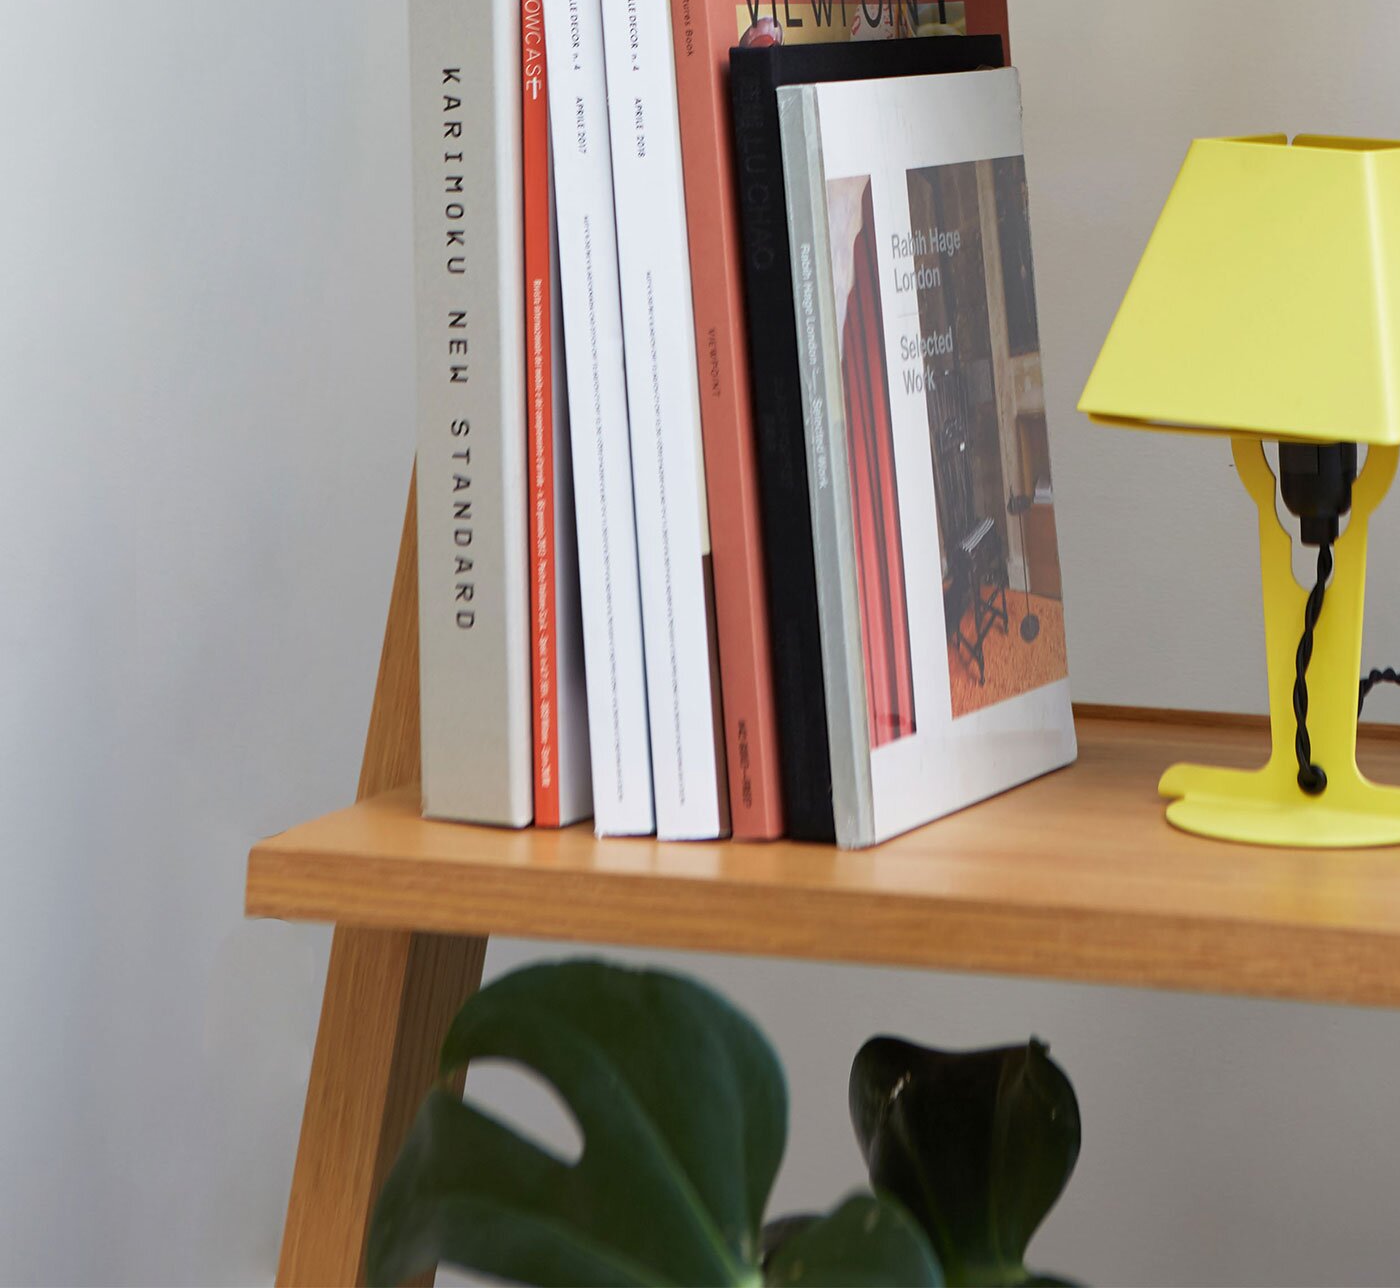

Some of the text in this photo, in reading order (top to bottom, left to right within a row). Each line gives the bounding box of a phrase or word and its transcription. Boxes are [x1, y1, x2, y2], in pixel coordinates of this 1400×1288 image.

[570, 15, 580, 48] DECOR
[629, 16, 639, 49] DECOR
[685, 29, 695, 57] Book
[575, 97, 585, 129] APRILE
[634, 98, 644, 131] APRILE
[891, 226, 961, 260] Rabih Hage
[799, 243, 812, 280] Rabih
[894, 264, 941, 293] London
[802, 282, 814, 315] Hage
[440, 66, 475, 630] KARIMOKU NEW STANDARD
[805, 318, 818, 365] London
[900, 326, 954, 362] Selected
[708, 327, 721, 398] VIEWPOINT
[903, 365, 936, 396] Work
